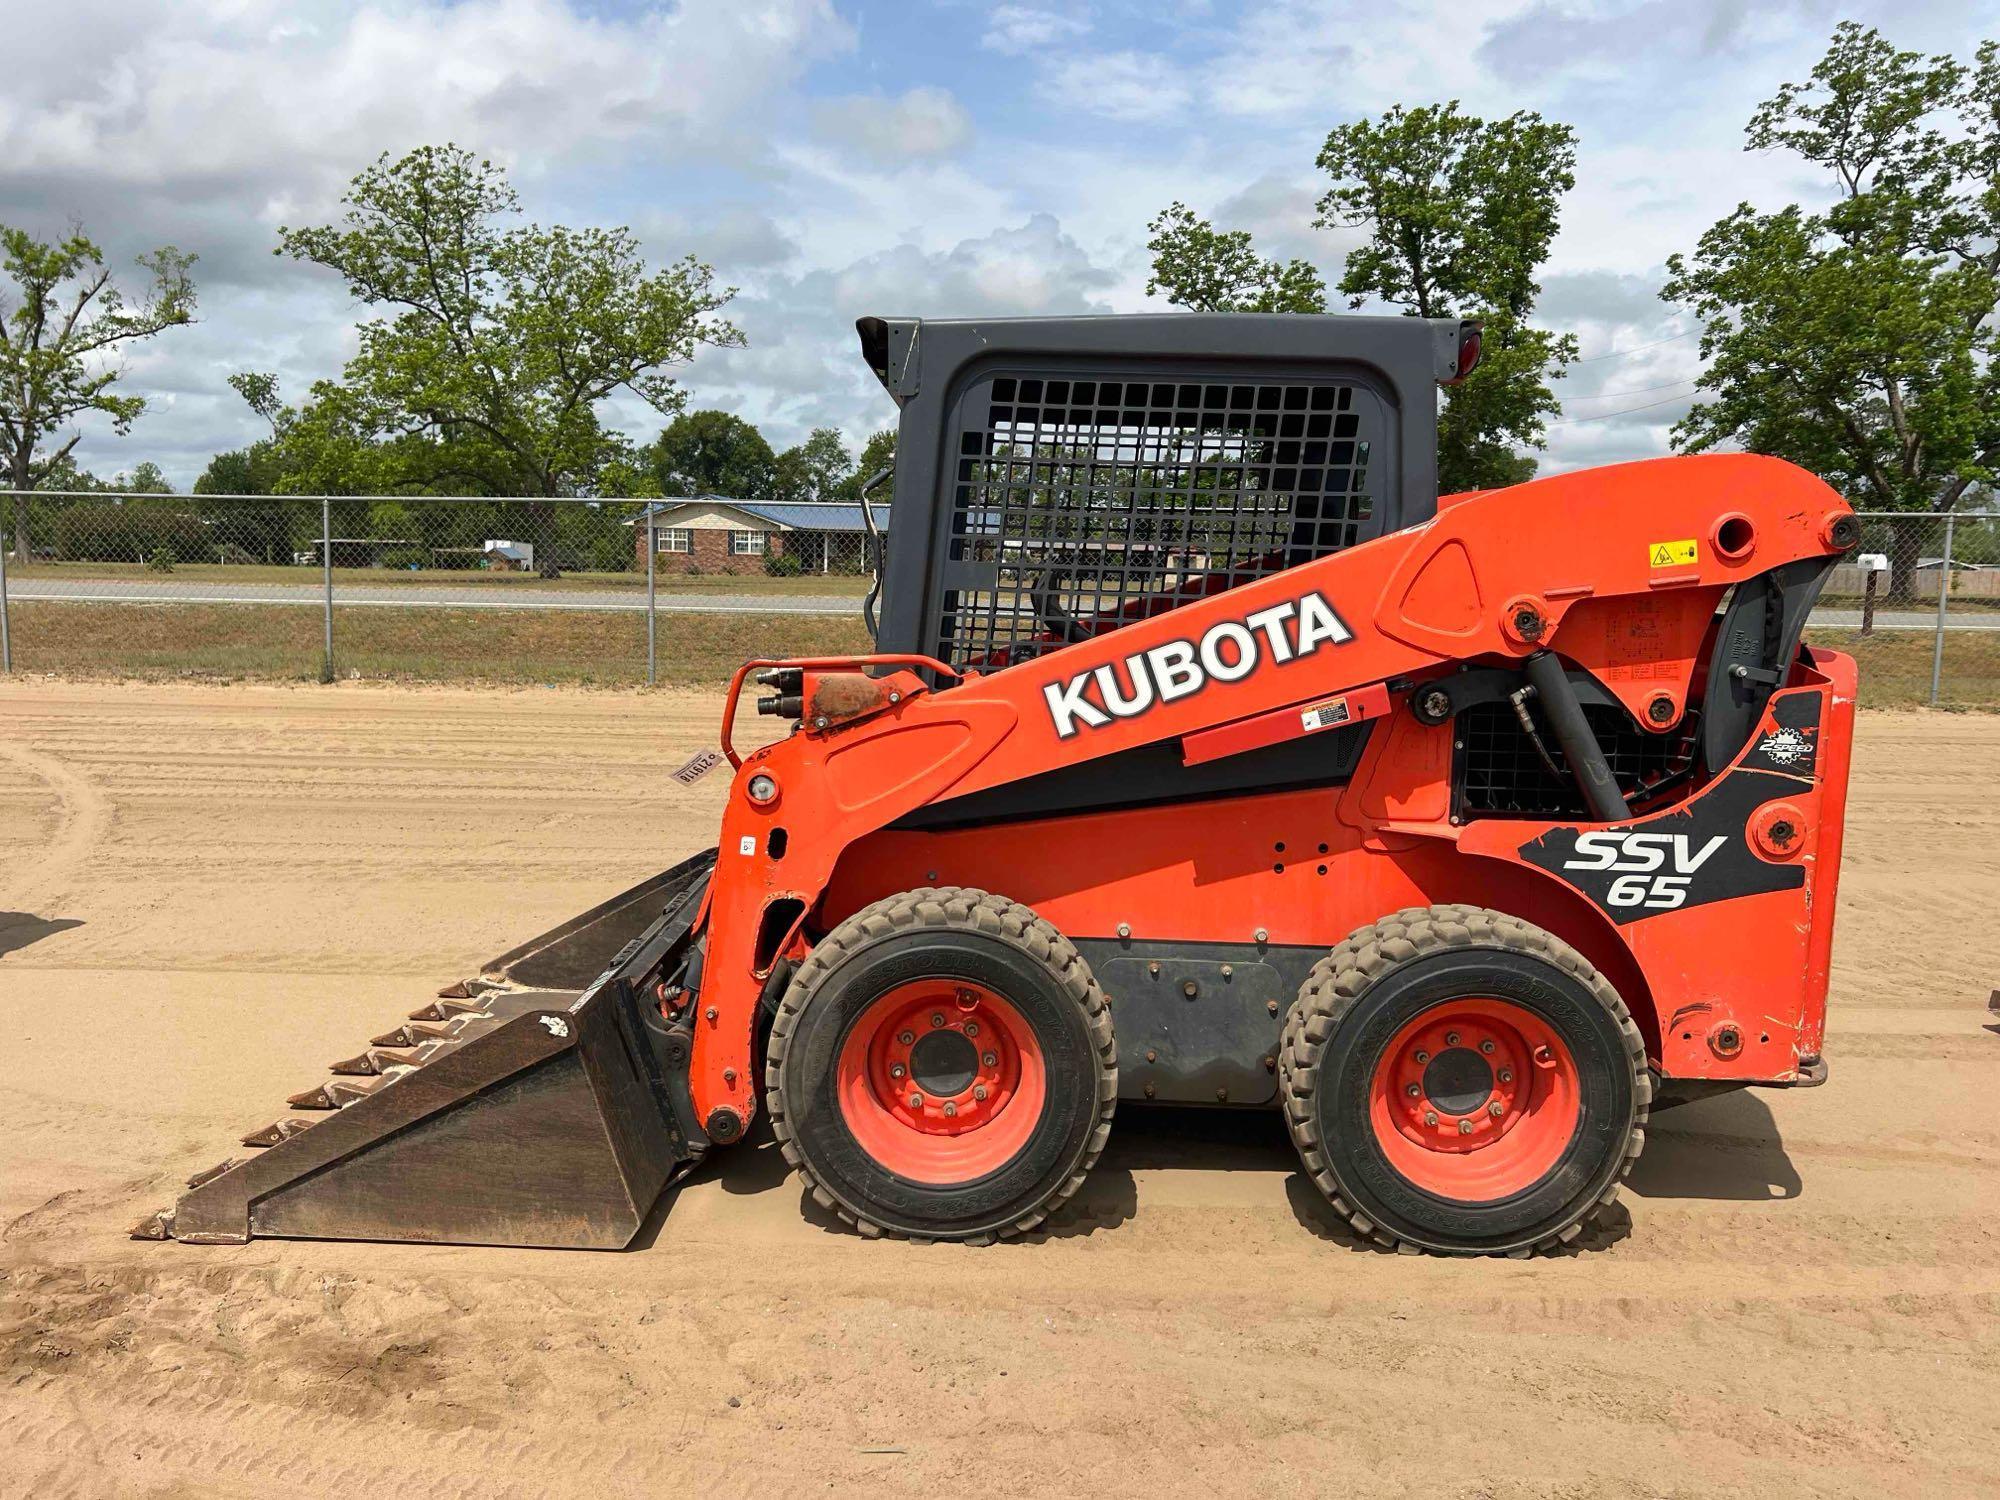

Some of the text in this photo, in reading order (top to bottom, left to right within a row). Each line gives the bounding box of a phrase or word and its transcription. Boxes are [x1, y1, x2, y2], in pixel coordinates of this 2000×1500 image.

[1043, 592, 1353, 739] KUBOTA
[1563, 831, 1729, 874] SSV
[1606, 875, 1693, 909] 65
